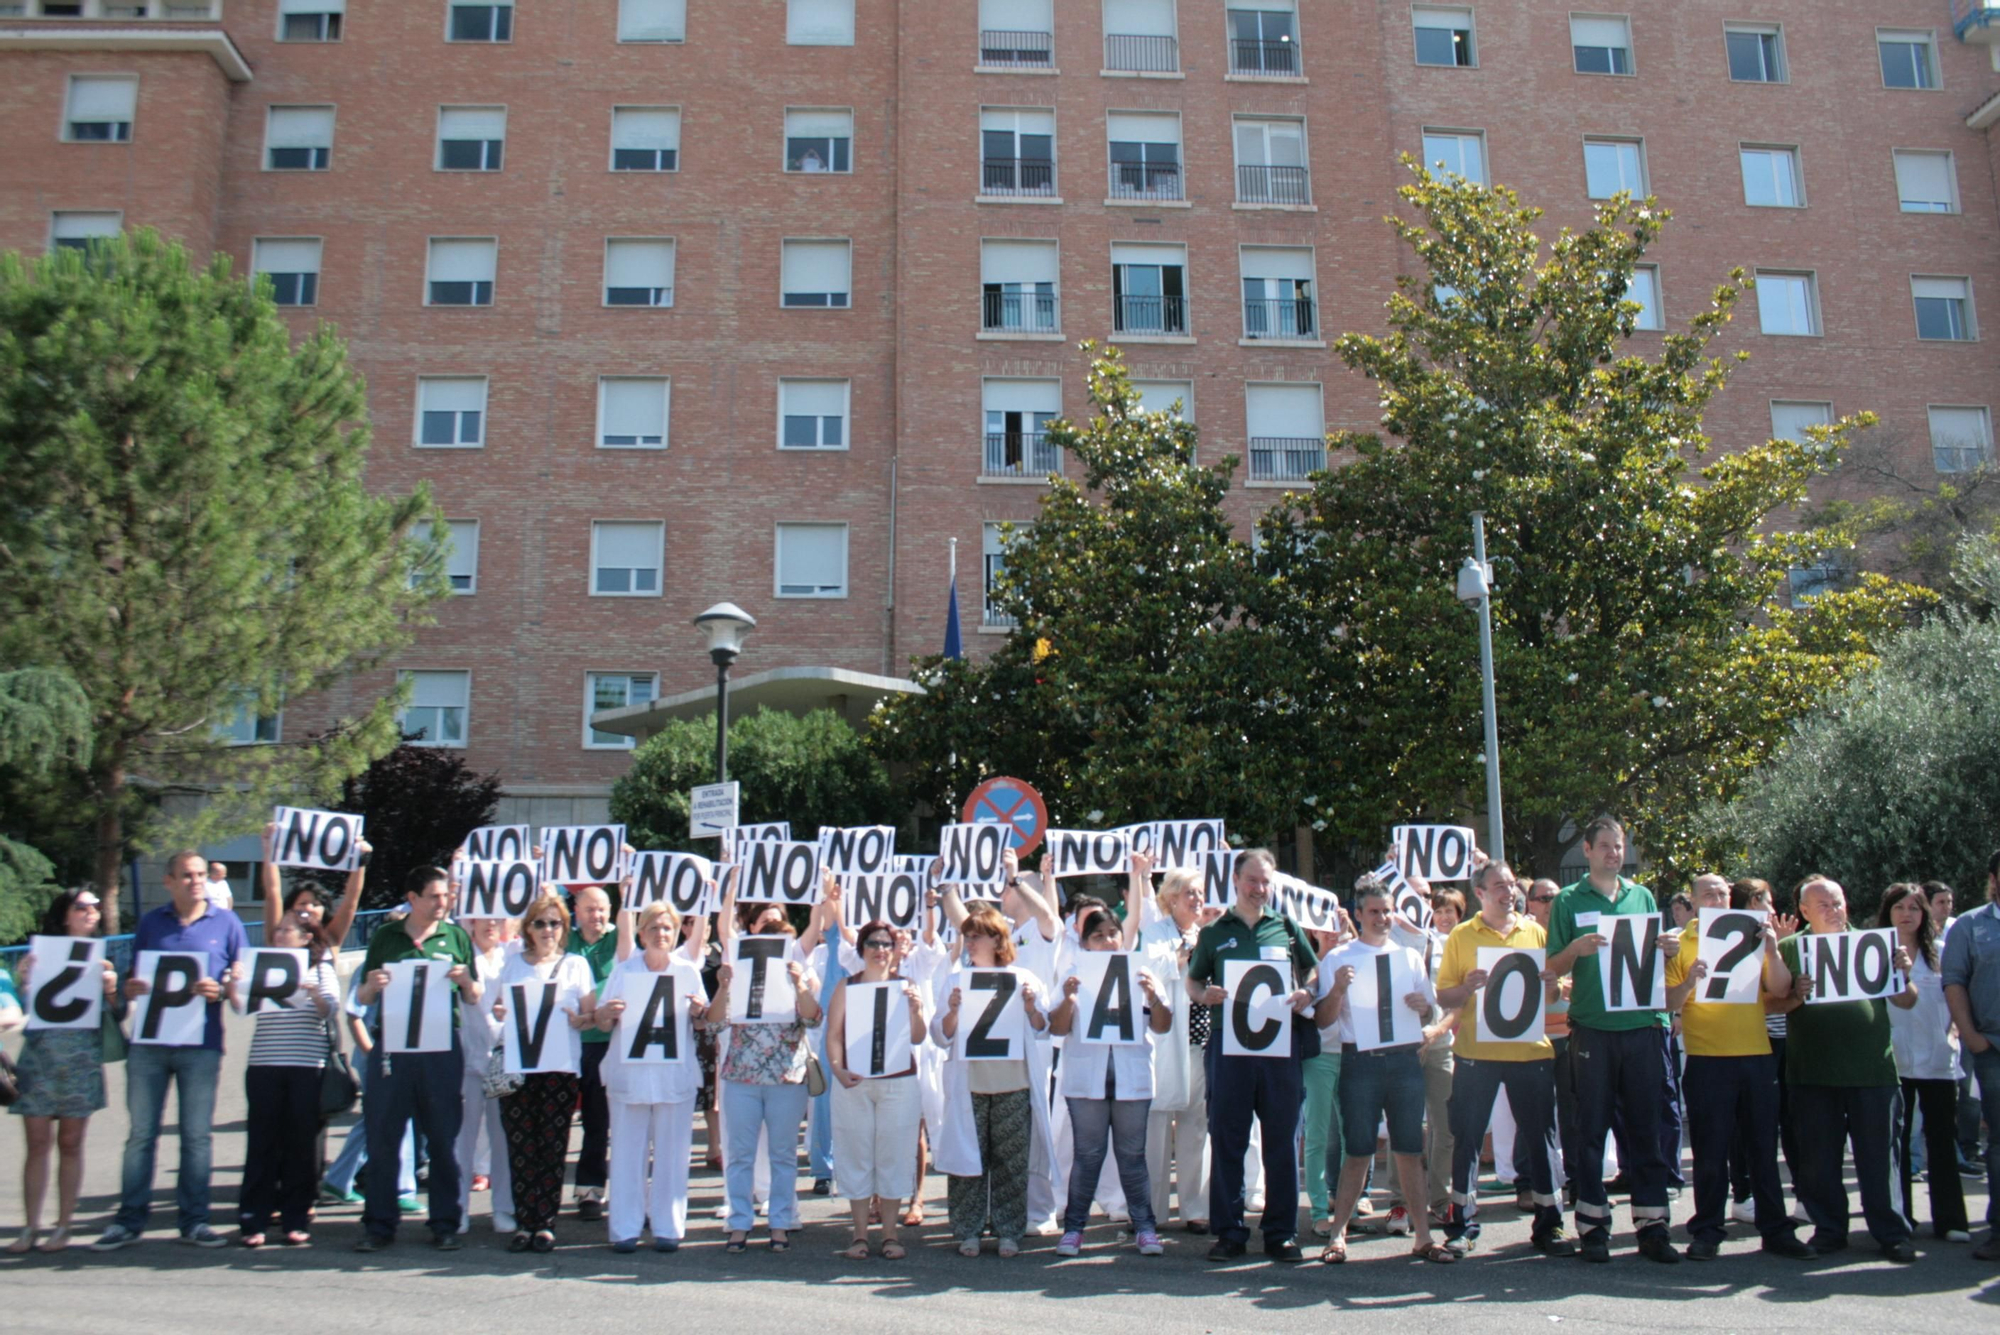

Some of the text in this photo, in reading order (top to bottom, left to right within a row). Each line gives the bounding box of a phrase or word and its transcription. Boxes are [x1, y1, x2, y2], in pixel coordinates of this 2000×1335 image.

[141, 955, 200, 1039] P
[246, 951, 302, 1014] R
[406, 966, 427, 1049] I
[510, 982, 558, 1070] V
[628, 975, 679, 1059] A
[738, 938, 787, 1020] T
[870, 986, 889, 1076] I
[965, 972, 1017, 1058] Z
[1087, 954, 1135, 1041] A
[1232, 964, 1285, 1052] C
[1375, 953, 1395, 1044] I
[1483, 952, 1541, 1039] O
[1610, 917, 1661, 1008] N
